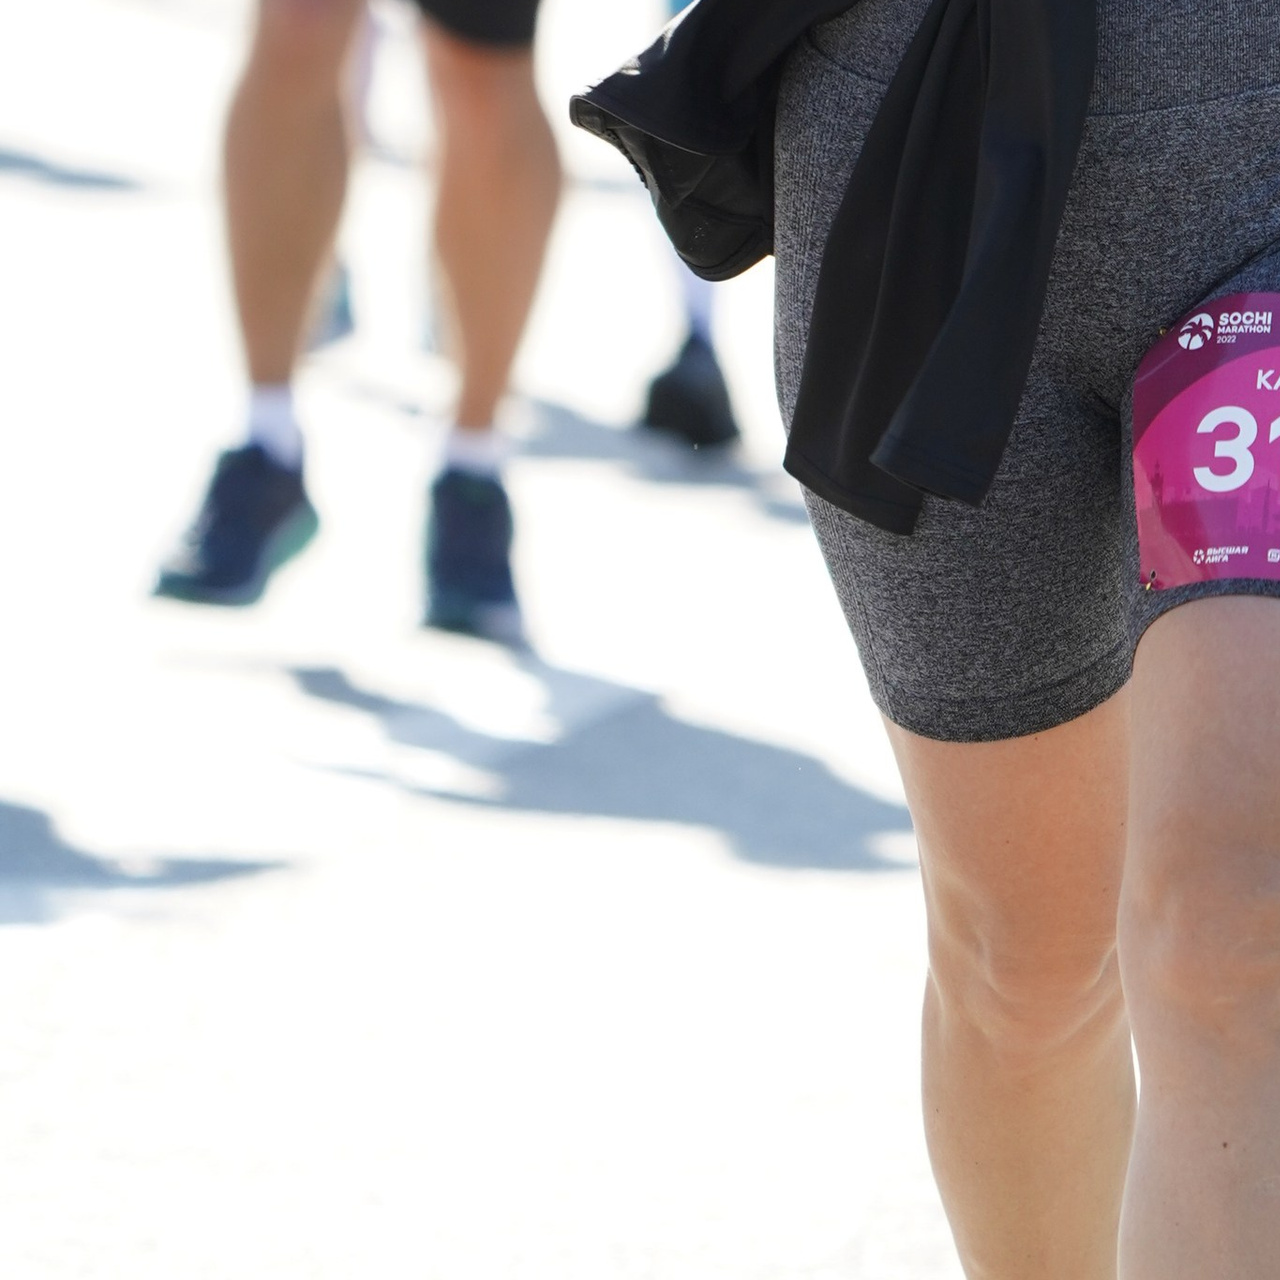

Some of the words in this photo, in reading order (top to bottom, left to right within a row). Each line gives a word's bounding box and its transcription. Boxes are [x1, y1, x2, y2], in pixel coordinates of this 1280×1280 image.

[1219, 311, 1272, 326] SOCHI
[1217, 324, 1271, 334] MARATHON
[1216, 334, 1237, 344] 2022
[1205, 554, 1229, 564] ЛИГА
